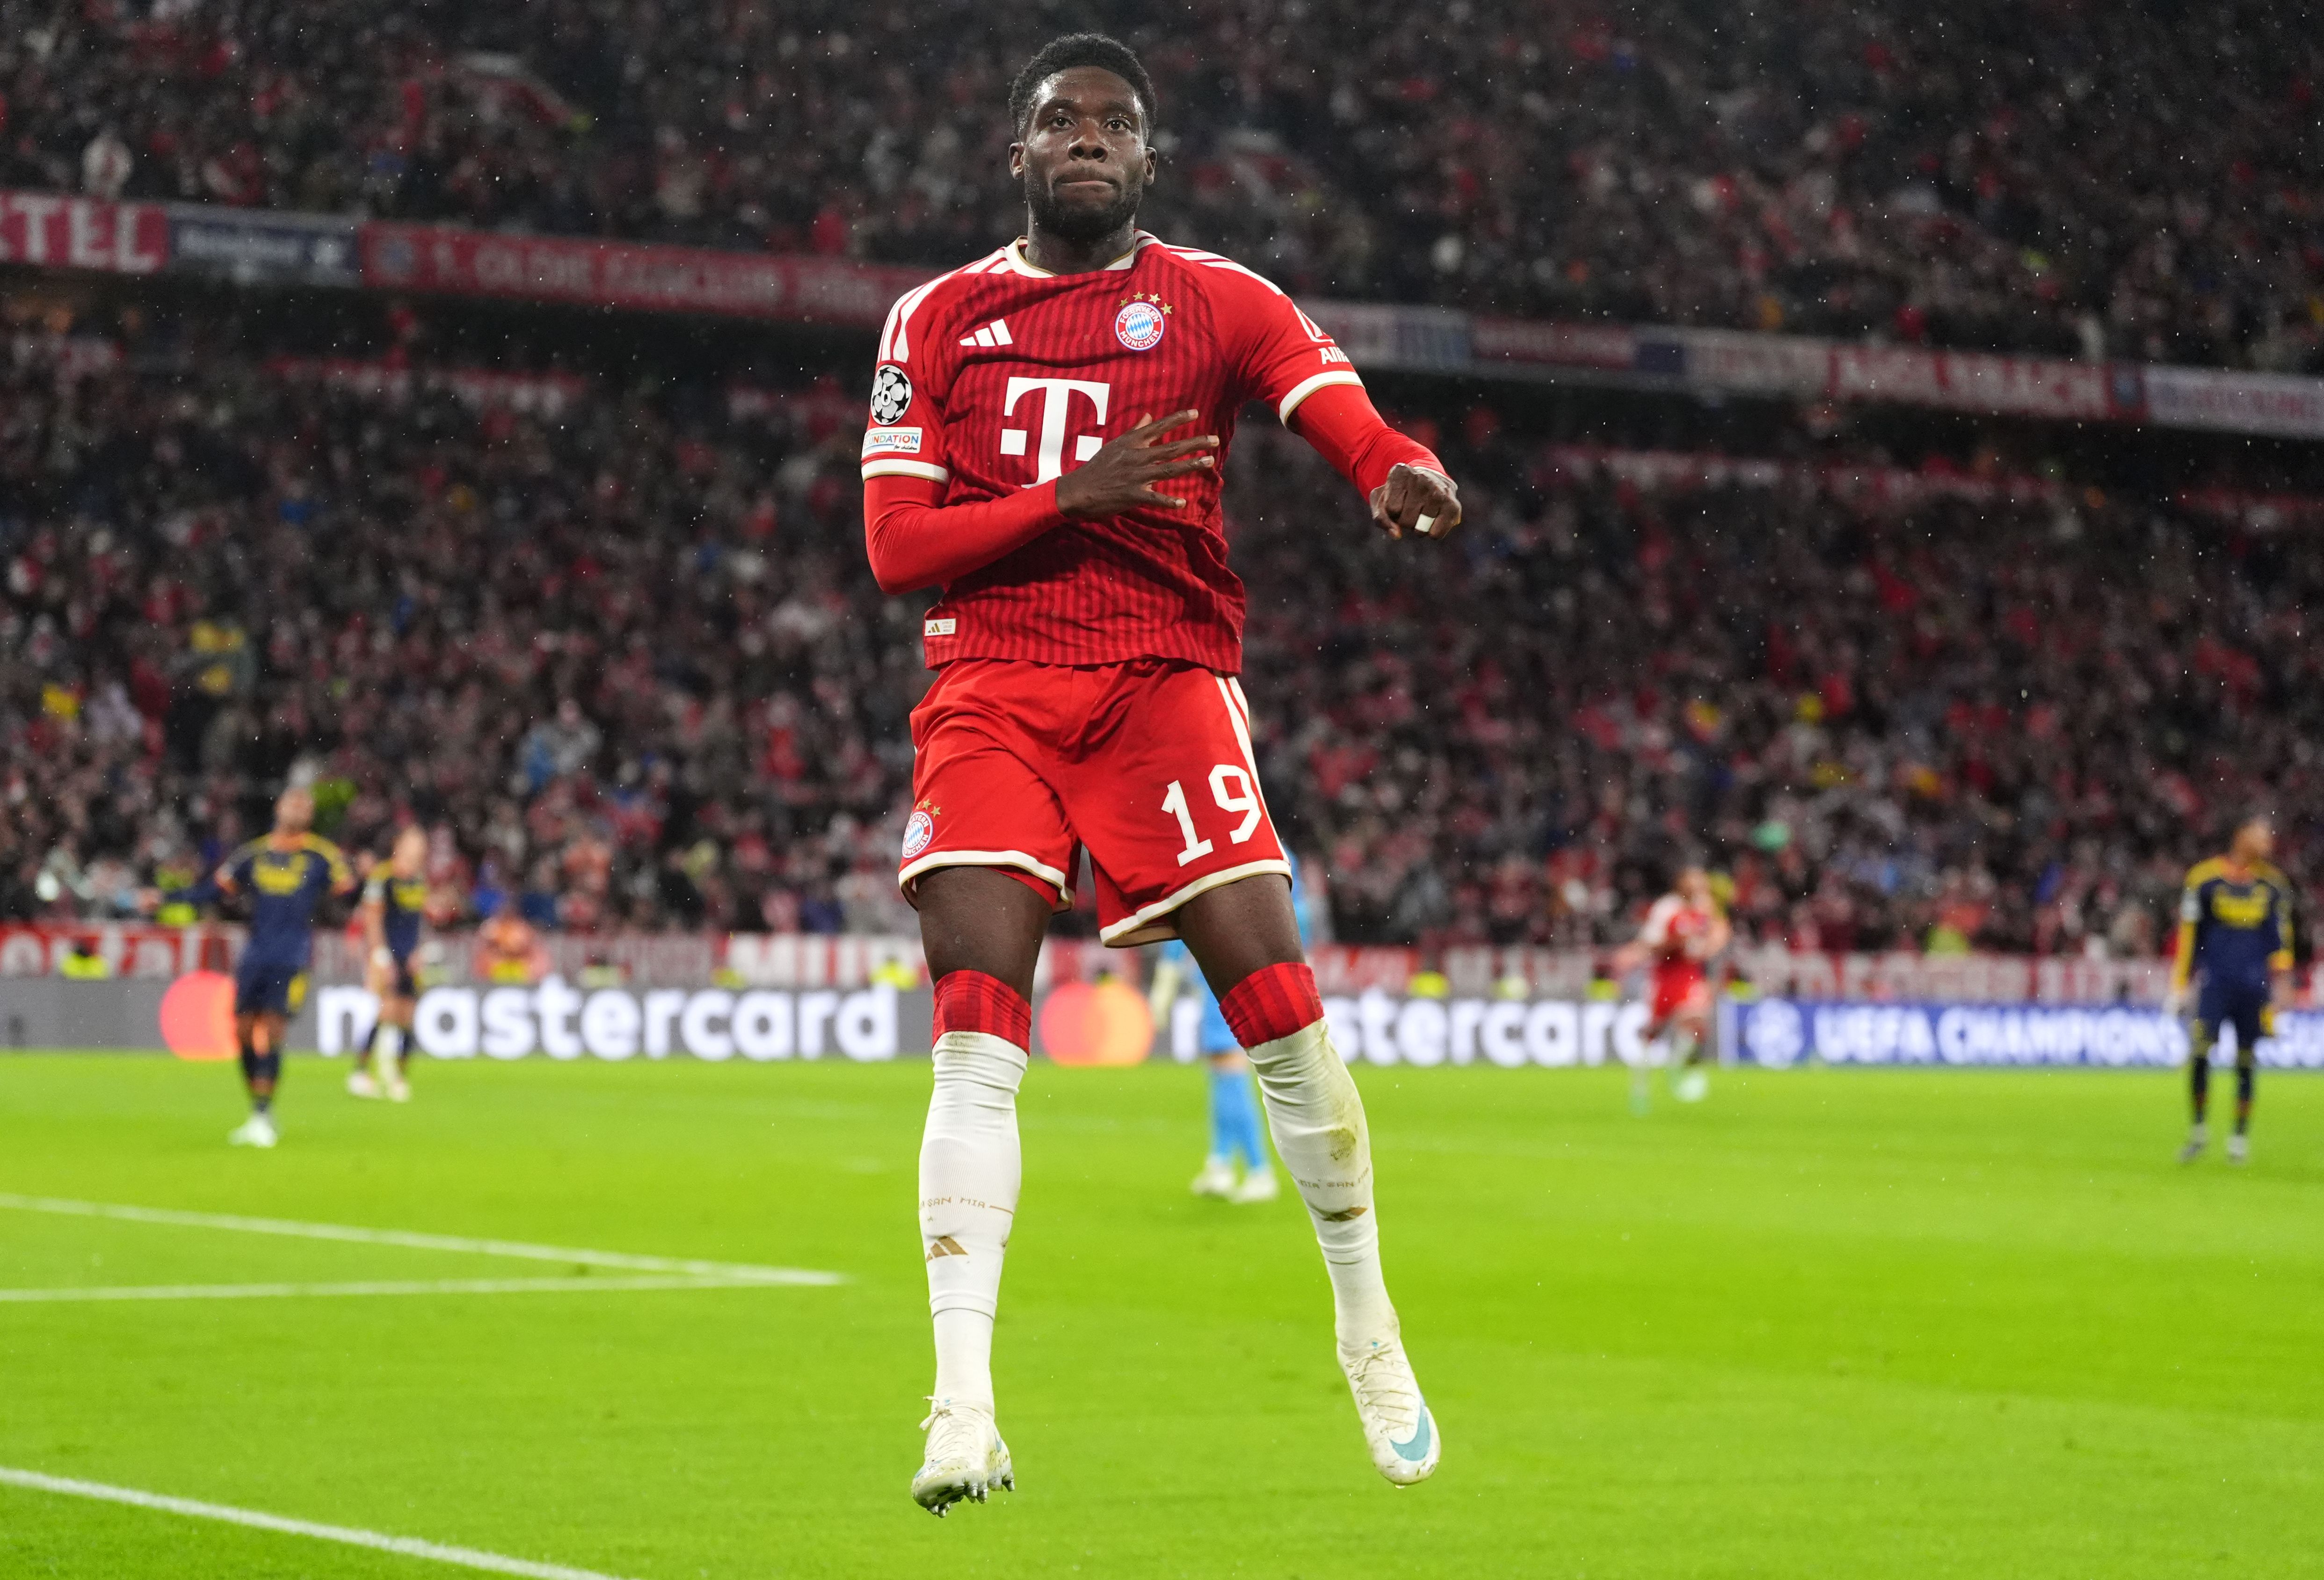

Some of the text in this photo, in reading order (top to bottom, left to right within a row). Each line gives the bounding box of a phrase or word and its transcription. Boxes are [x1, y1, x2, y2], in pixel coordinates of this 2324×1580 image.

[0, 191, 163, 274] TEL
[1126, 306, 1160, 323] BAYERN
[1119, 330, 1160, 347] MÜNCHEN
[1161, 764, 1262, 867] 19
[927, 1196, 951, 1207] SAN
[959, 1197, 985, 1209] MIA
